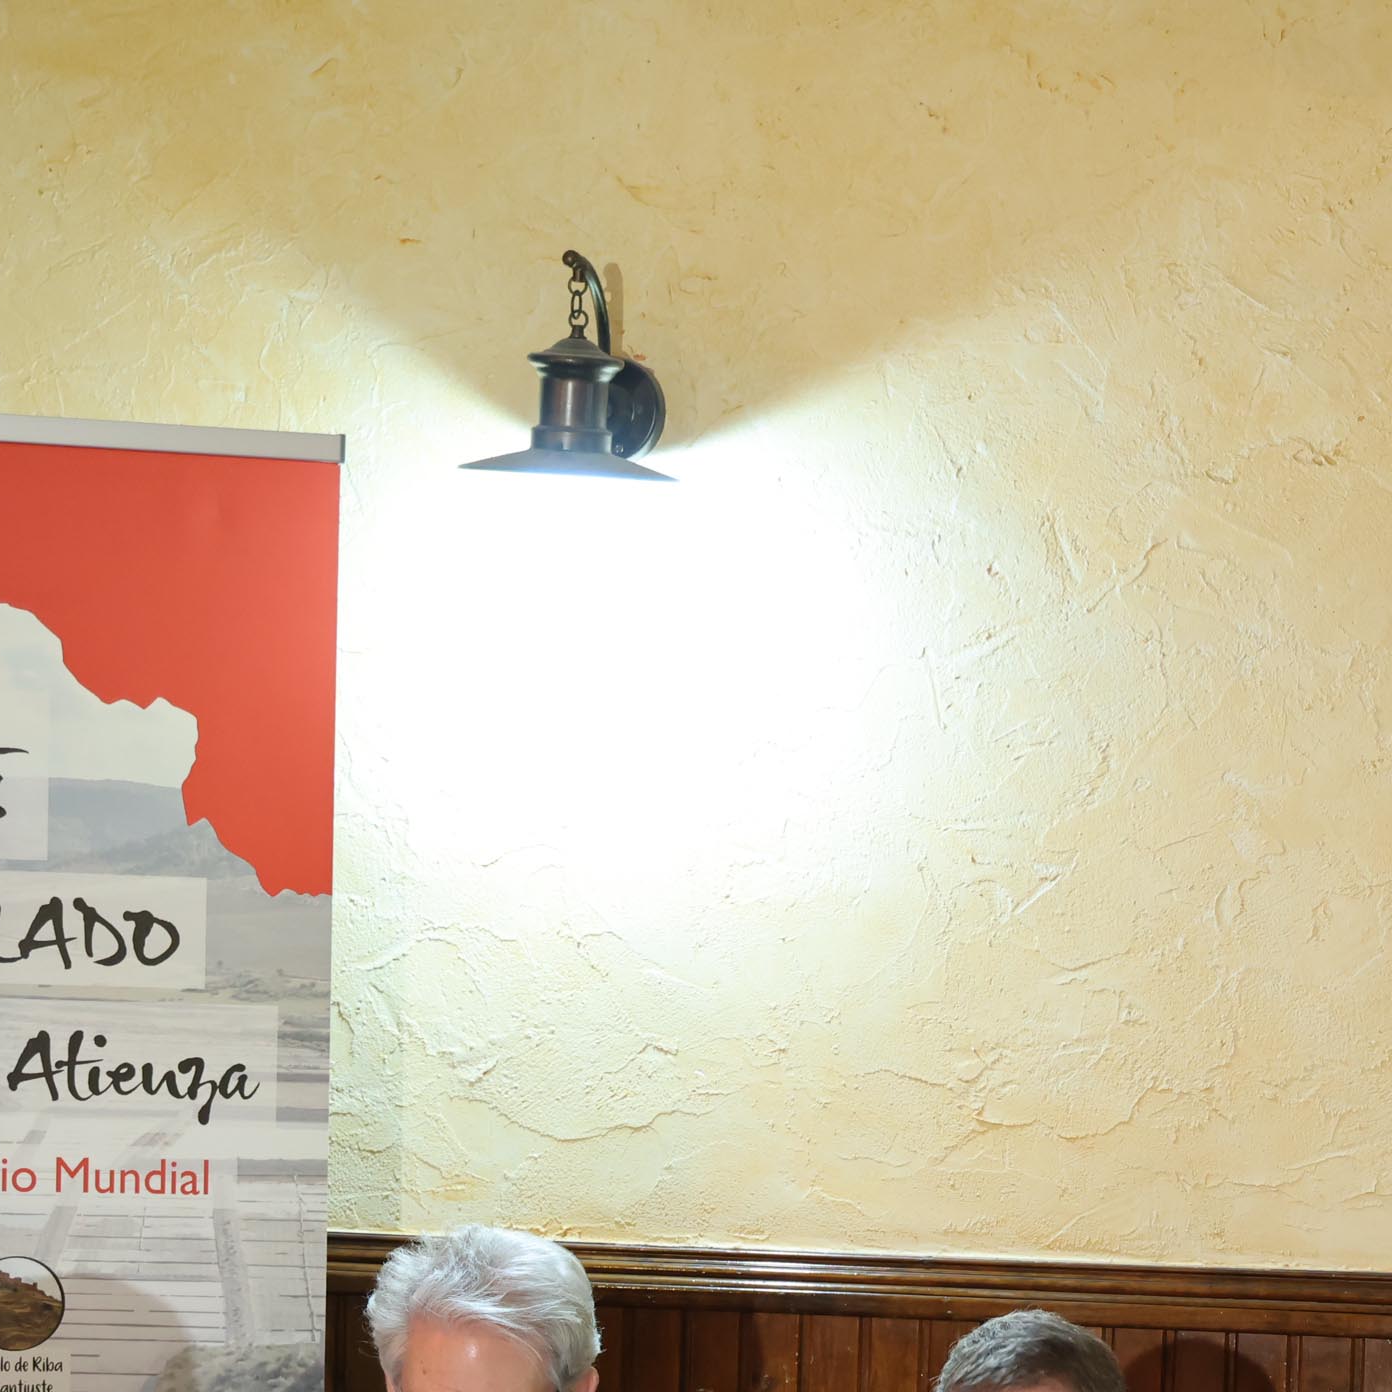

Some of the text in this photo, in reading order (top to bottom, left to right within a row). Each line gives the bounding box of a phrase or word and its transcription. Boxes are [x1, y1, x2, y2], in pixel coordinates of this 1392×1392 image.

[6, 1030, 260, 1126] Atienza
[55, 1156, 211, 1197] Mundial
[14, 1355, 28, 1373] de
[32, 1356, 63, 1373] Riba
